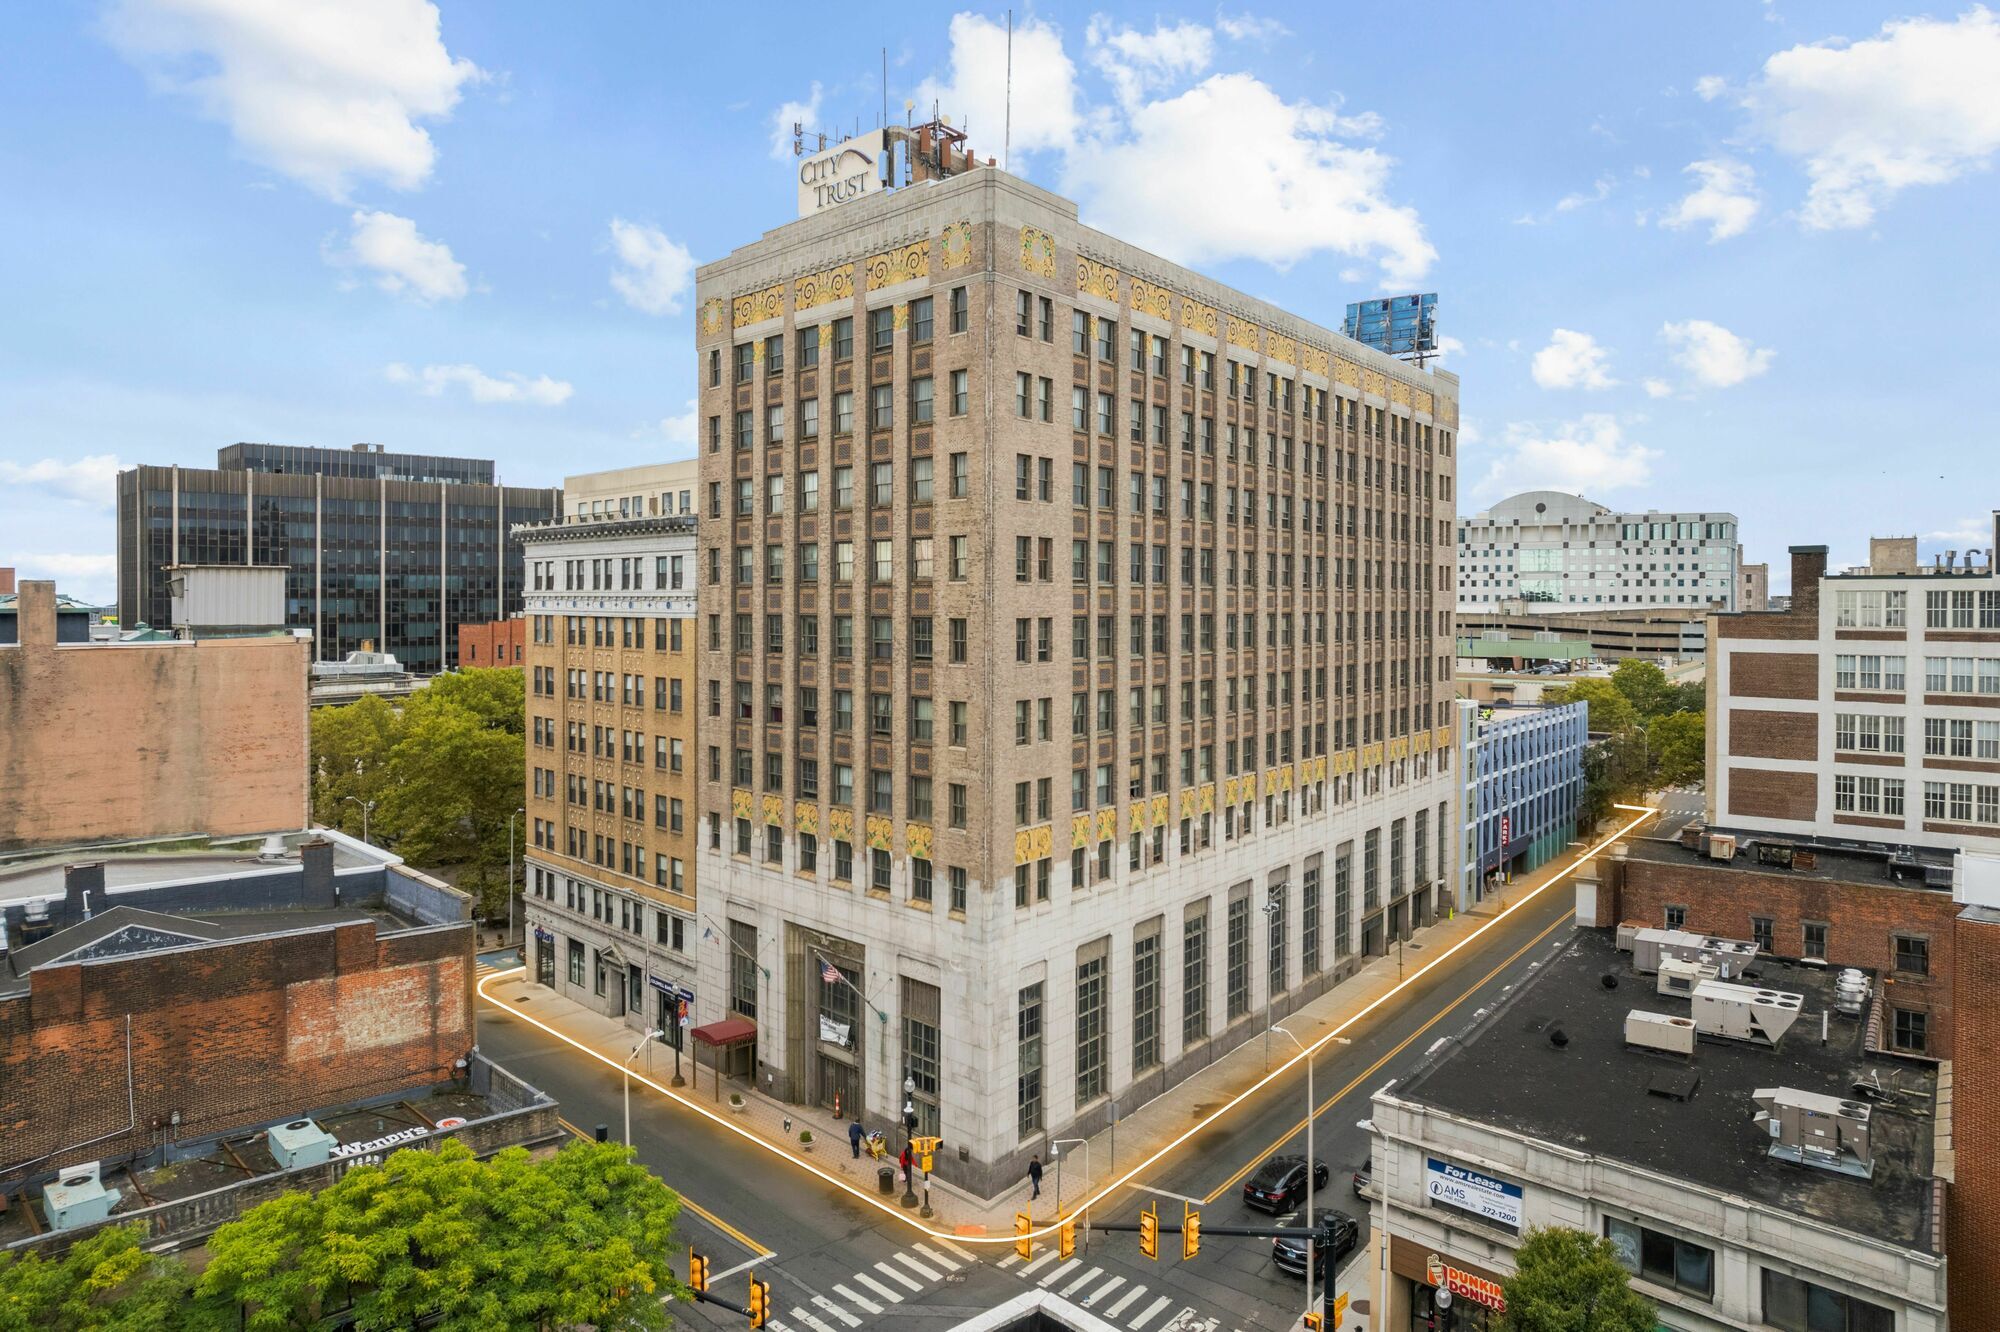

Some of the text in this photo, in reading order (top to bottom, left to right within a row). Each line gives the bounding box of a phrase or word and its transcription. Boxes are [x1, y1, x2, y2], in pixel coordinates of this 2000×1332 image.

[800, 154, 840, 185] CITY
[813, 171, 868, 208] TRUST
[1439, 1175, 1505, 1199] www.amsrealestate.com
[1444, 1165, 1503, 1191] For Lease
[1444, 1185, 1466, 1199] AMS
[1481, 1206, 1517, 1222] 372-1200
[1448, 1280, 1507, 1312] DONUTS
